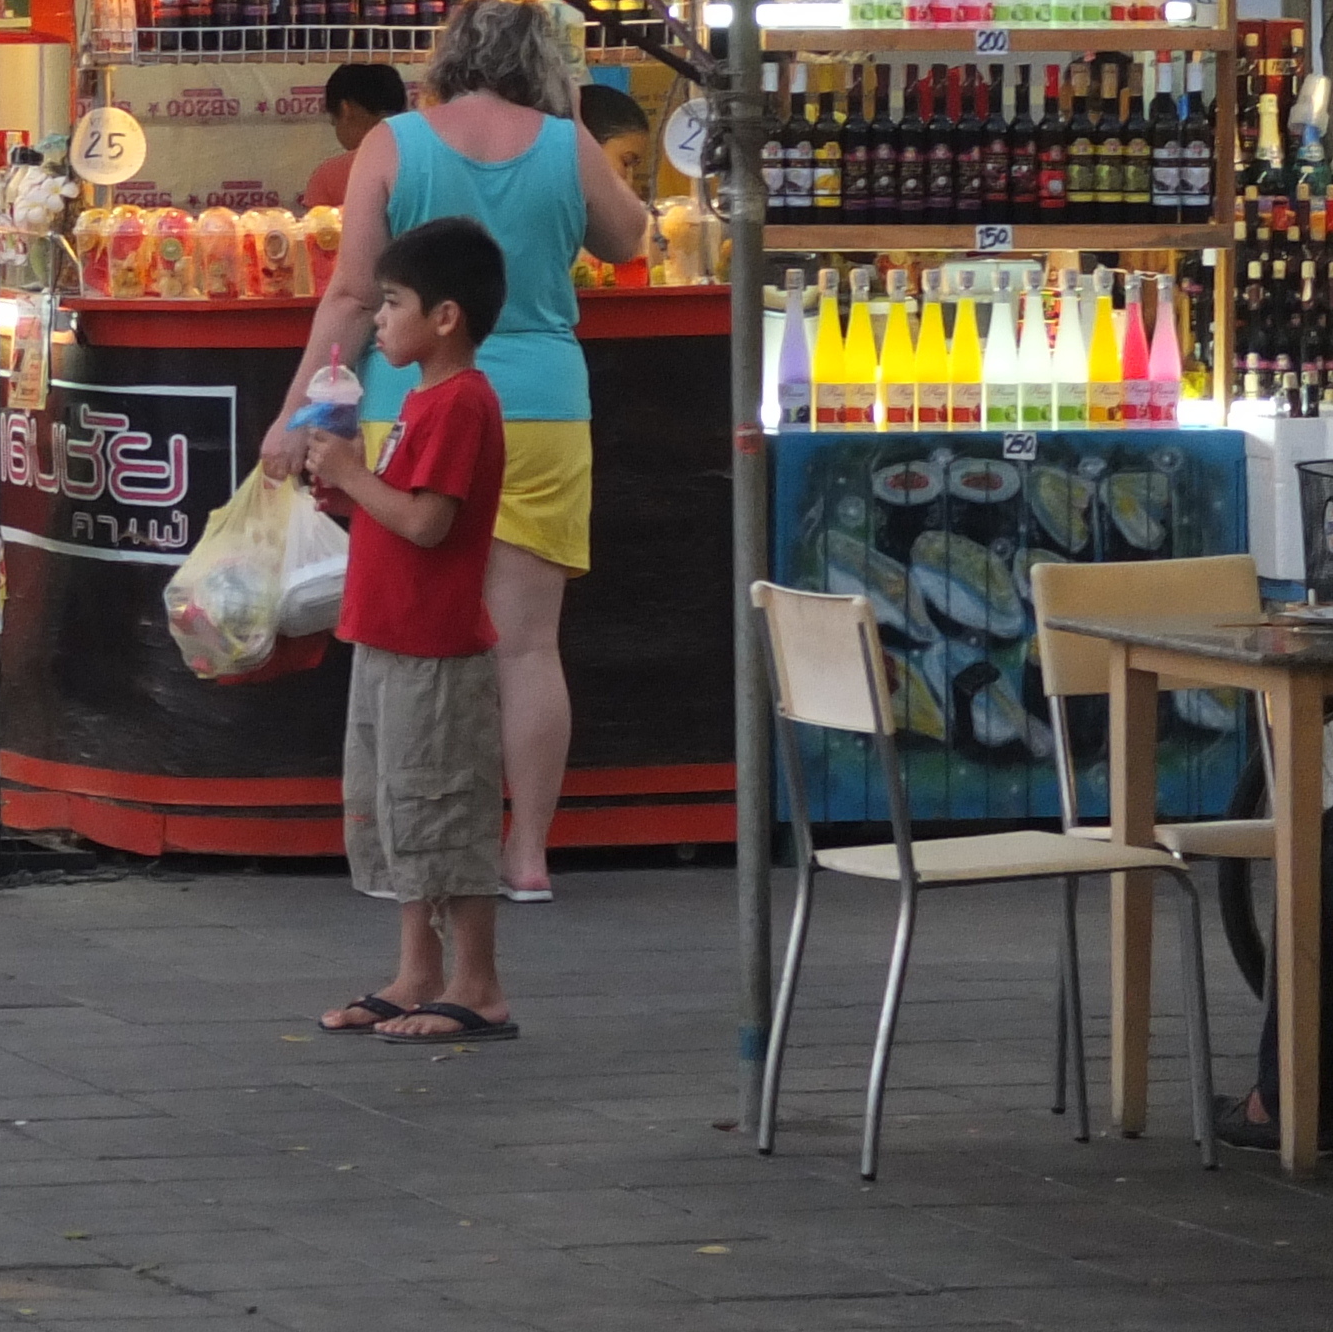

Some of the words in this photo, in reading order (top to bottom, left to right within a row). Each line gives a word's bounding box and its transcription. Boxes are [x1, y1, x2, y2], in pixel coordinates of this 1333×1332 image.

[977, 31, 1007, 53] 200
[84, 131, 126, 160] 25
[678, 116, 703, 152] 2
